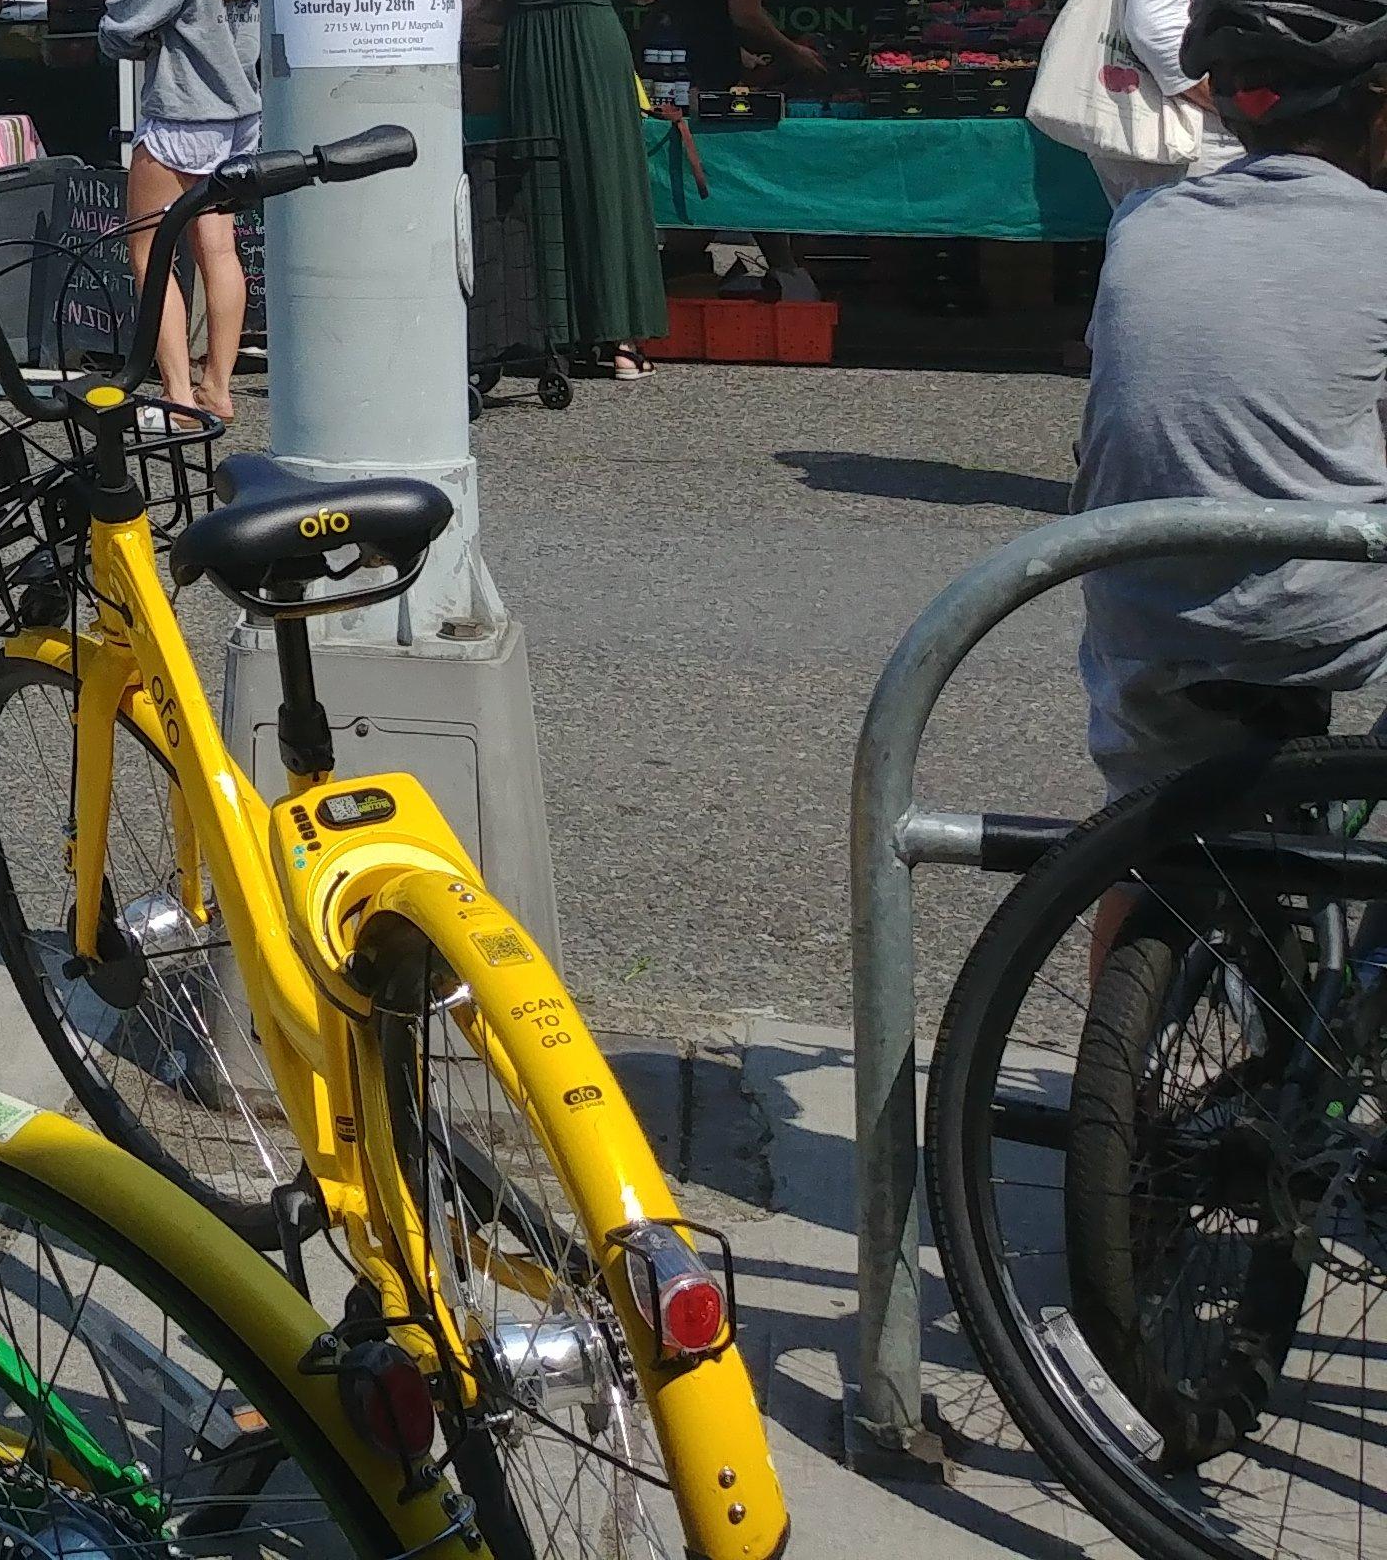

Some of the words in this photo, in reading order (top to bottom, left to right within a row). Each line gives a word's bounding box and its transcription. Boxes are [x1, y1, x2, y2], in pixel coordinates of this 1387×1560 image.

[324, 22, 348, 33] 2715
[350, 22, 363, 32] W.
[365, 21, 390, 34] Lynn
[408, 19, 444, 33] Magnolia
[299, 507, 350, 538] ofo
[151, 675, 180, 748] ofo
[510, 997, 566, 1022] SCAN
[530, 1013, 561, 1031] TO
[540, 1030, 573, 1050] GO
[569, 1085, 598, 1105] ofo
